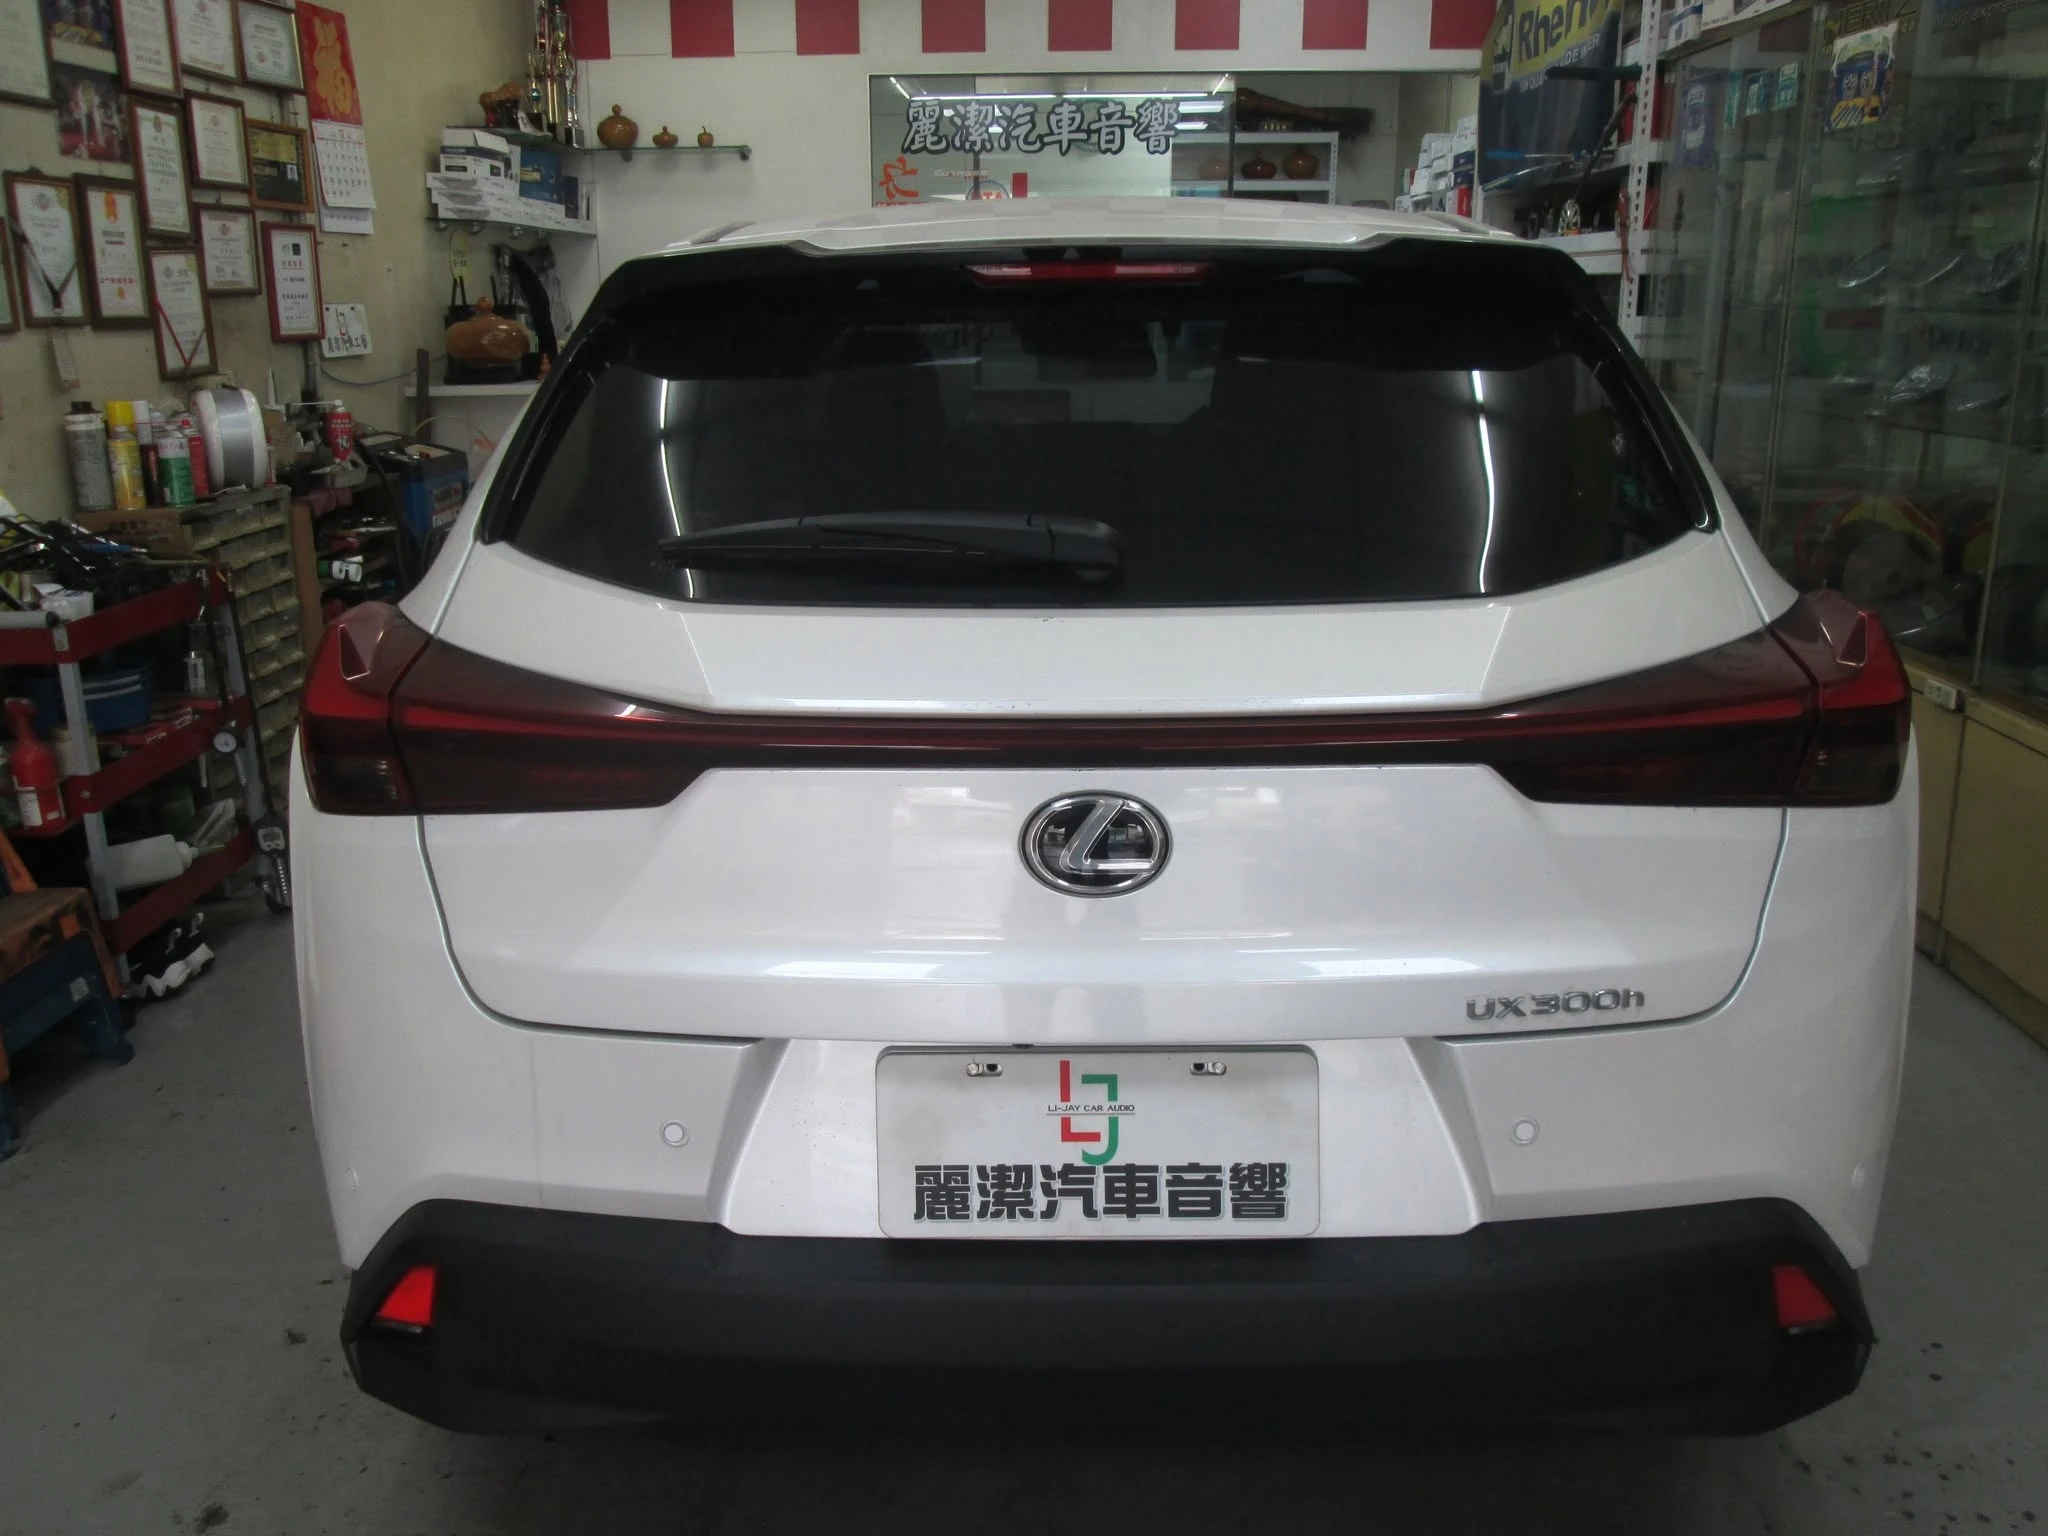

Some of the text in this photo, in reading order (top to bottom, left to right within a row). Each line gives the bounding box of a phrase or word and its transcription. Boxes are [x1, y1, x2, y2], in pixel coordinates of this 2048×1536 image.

[902, 98, 1181, 156] 麗潔汽車音響
[1465, 987, 1646, 1021] UX300h
[1047, 1104, 1136, 1112] LI-JAY CAR AUDIO
[913, 1161, 1289, 1222] 麗潔汽車音響
